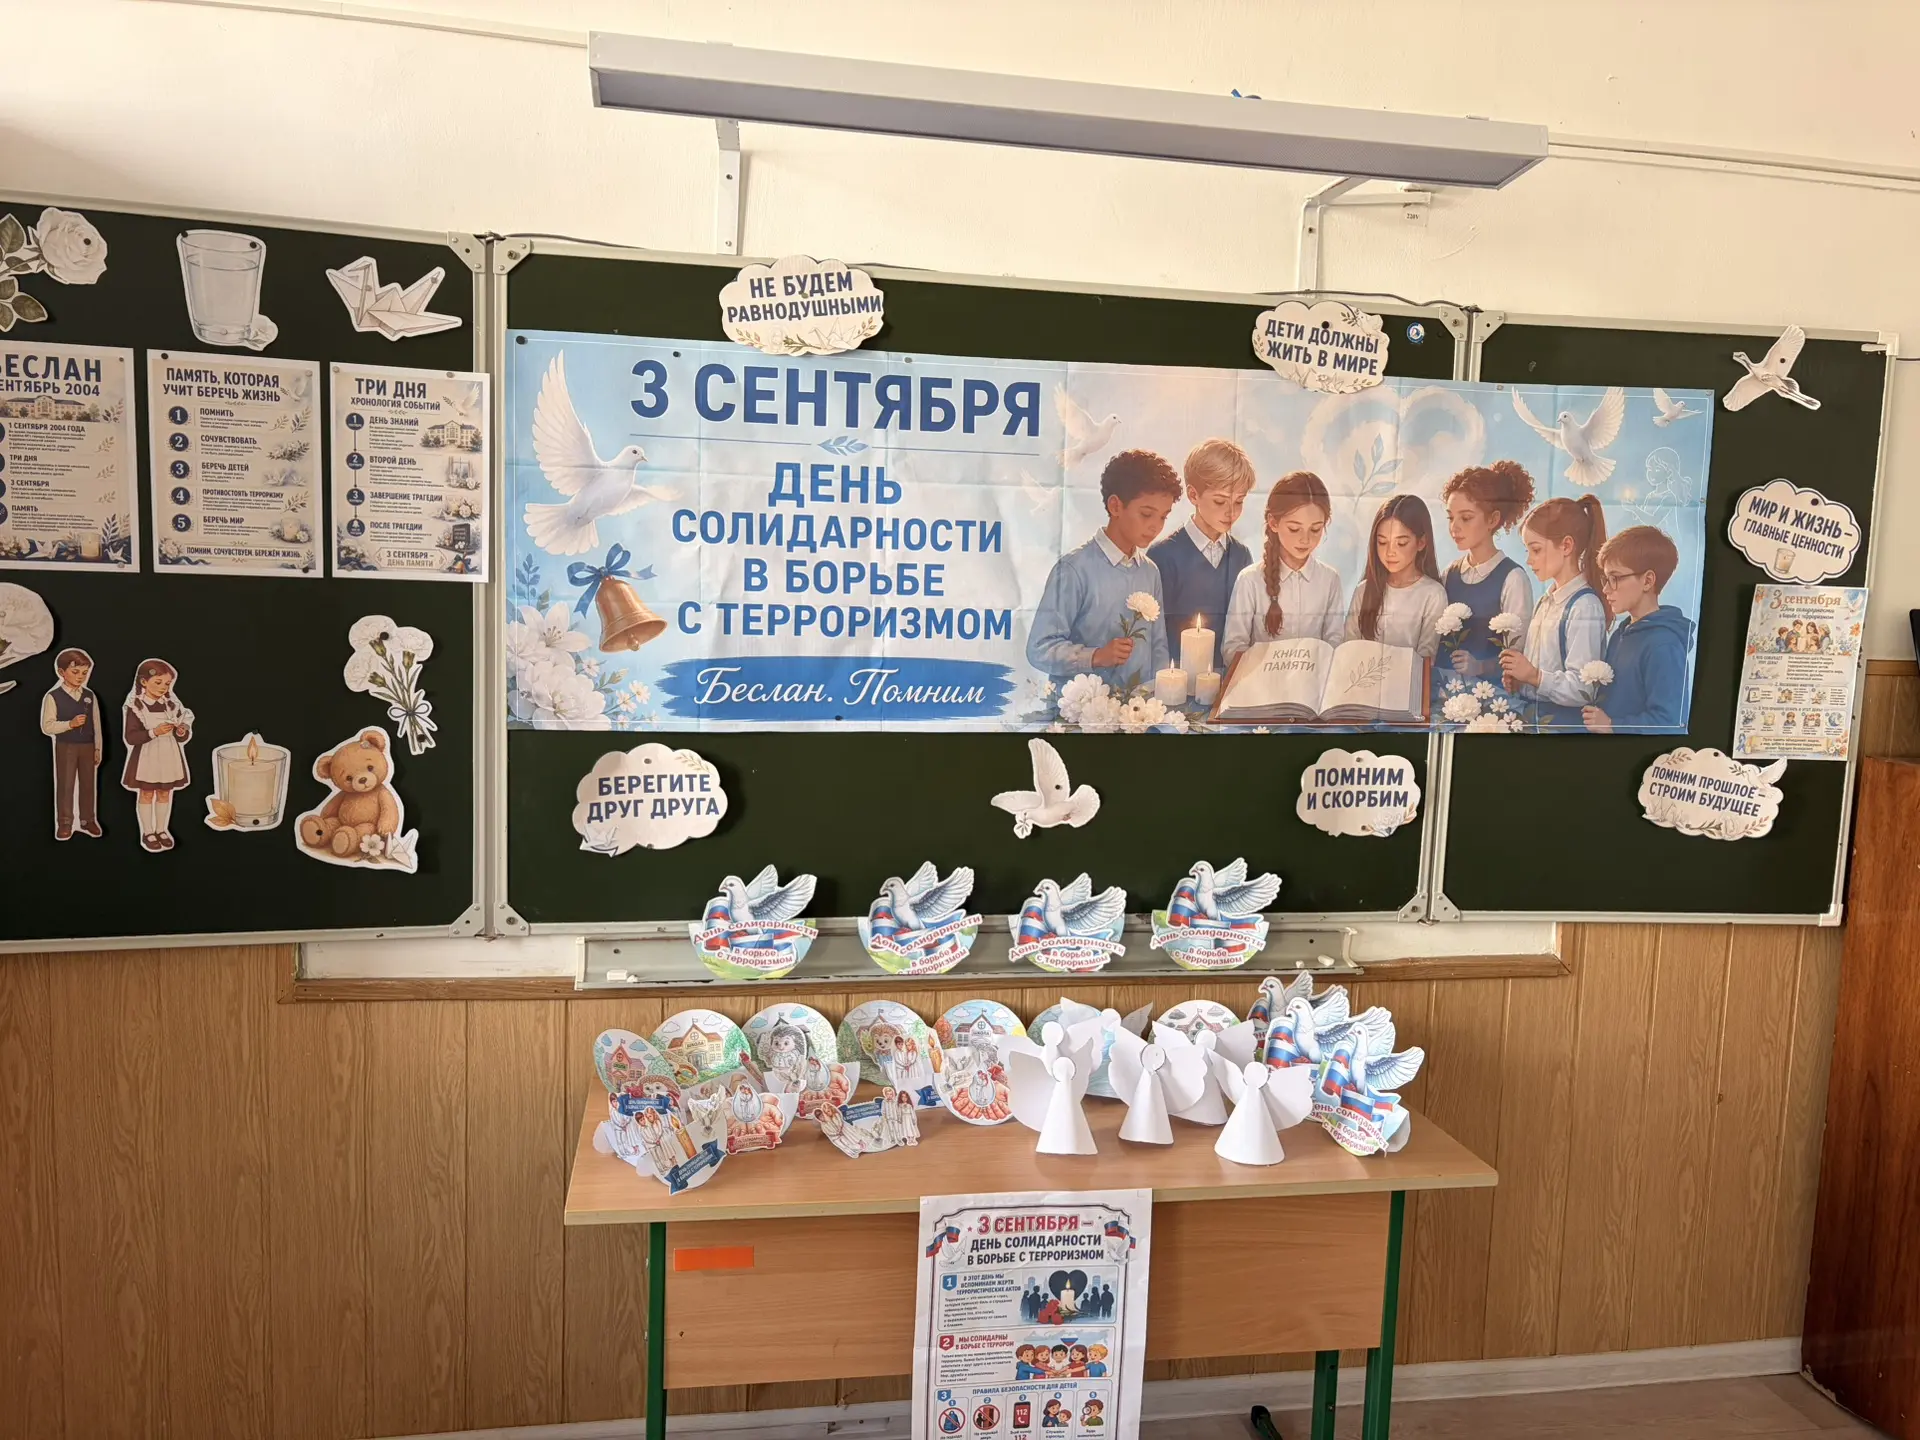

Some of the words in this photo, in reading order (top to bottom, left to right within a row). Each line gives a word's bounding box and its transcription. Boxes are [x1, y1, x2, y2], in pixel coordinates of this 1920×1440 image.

[750, 277, 776, 299] НЕ
[783, 271, 853, 297] БУДЕМ
[727, 295, 882, 323] РАВНОДУШНЫМИ
[1265, 318, 1305, 341] ДЕТИ
[1308, 327, 1379, 354] ДОЛЖНЫ
[1266, 339, 1312, 365] ЖИТЬ
[1317, 349, 1328, 367] В
[1332, 352, 1378, 376] МИРЕ
[0, 354, 102, 382] ЕСЛАН
[166, 367, 220, 385] ПАМЯТЬ,
[224, 372, 280, 388] КОТОРАЯ
[65, 383, 100, 396] 2004
[163, 384, 193, 396] УЧИТ
[197, 388, 239, 400] БЕРЕЧЬ
[242, 390, 281, 402] ЖИЗНЬ
[355, 378, 387, 396] ТРИ
[393, 381, 427, 399] ДНЯ
[350, 397, 401, 408] ХРОНОЛОГИЯ
[403, 400, 440, 411] СОБЫТИЙ
[630, 359, 669, 419] 3
[694, 362, 1042, 438] СЕНТЯБРЯ
[175, 410, 182, 421] 1
[200, 407, 234, 418] ПОМНИТЬ
[352, 415, 357, 423] 1
[14, 422, 48, 431] СЕНТЯБРЯ
[369, 416, 389, 426] ДЕНЬ
[390, 417, 419, 427] ЗНАНИЙ
[175, 436, 183, 448] 2
[200, 435, 257, 445] СОЧУВСТВОВАТЬ
[9, 454, 22, 462] ТРИ
[352, 455, 358, 463] 2
[370, 455, 396, 465] ВТОРОЙ
[398, 457, 416, 466] ДЕНЬ
[176, 464, 184, 475] 3
[201, 462, 226, 471] БЕРЕЧЬ
[228, 463, 249, 472] ДЕТЕЙ
[16, 480, 50, 488] СЕНТЯБРЯ
[767, 462, 903, 509] ДЕНЬ
[176, 491, 184, 502] 4
[202, 489, 249, 498] ПРОТИВОСТОЯТЬ
[249, 490, 284, 499] ТЕРРОРИЗМУ
[353, 491, 358, 499] 3
[370, 491, 410, 501] ЗАВЕРШЕНИЕ
[412, 493, 443, 502] ТРАГЕДИИ
[11, 505, 38, 513] ПАМЯТЬ
[177, 518, 185, 529] 5
[203, 515, 228, 524] БЕРЕЧЬ
[230, 516, 244, 524] МИР
[1748, 496, 1778, 519] МИР
[1778, 505, 1791, 524] И
[1790, 509, 1843, 539] ЖИЗНЬ
[370, 521, 391, 530] ПОСЛЕ
[392, 522, 423, 531] ТРАГЕДИИ
[672, 508, 1003, 554] СОЛИДАРНОСТИ
[1743, 518, 1791, 544] ГЛАВНЫЕ
[1791, 532, 1845, 559] ЦЕННОСТИ
[254, 548, 280, 558] БЕРЕЖЁМ
[392, 551, 428, 559] СЕНТЯБРЯ
[387, 559, 404, 567] ДЕНЬ
[406, 559, 433, 567] ПАМЯТИ
[743, 558, 769, 593] В
[785, 559, 945, 597] БОРЬБЕ
[1769, 589, 1782, 610] 3
[1784, 593, 1842, 608] сентября
[677, 601, 702, 635] С
[716, 602, 1012, 641] ТЕРРОРИЗМОМ
[1272, 648, 1311, 659] КНИГА
[1263, 660, 1315, 672] ПАМЯТИ
[694, 665, 833, 706] Беслан.
[846, 667, 987, 708] Помним
[1314, 768, 1405, 787] ПОМНИМ
[1651, 766, 1697, 786] ПОМНИМ
[1698, 776, 1757, 799] ПРОШЛОЕ
[598, 774, 712, 797] БЕРЕГИТЕ
[1307, 792, 1317, 810] И
[1321, 791, 1409, 809] СКОРБИМ
[1650, 782, 1697, 804] СТРОИМ
[1698, 792, 1761, 817] БУДУЩЕЕ
[587, 799, 644, 824] ДРУГ
[650, 798, 720, 820] ДРУГА
[693, 927, 725, 944] День
[728, 920, 817, 937] солидарности
[900, 916, 981, 955] солидарности
[1152, 933, 1179, 946] День
[1182, 929, 1264, 948] солидарности
[742, 948, 776, 958] борьбе
[1010, 945, 1039, 960] День
[1042, 938, 1124, 953] солидарности
[1060, 950, 1092, 959] борьбе
[1196, 948, 1227, 957] борьбе
[726, 954, 793, 967] терроризмом
[907, 950, 967, 975] терроризмом
[919, 950, 950, 966] борьбе
[1045, 955, 1109, 967] терроризмом
[1182, 954, 1242, 965] терроризмом
[1313, 1103, 1334, 1113] ень
[1336, 1106, 1388, 1149] солидарност
[1330, 1127, 1374, 1152] терроризмом
[1343, 1126, 1366, 1142] борьбе
[977, 1216, 990, 1234] 3
[994, 1215, 1079, 1233] СЕНТЯБРЯ
[970, 1238, 1002, 1253] ДЕНЬ
[1004, 1234, 1102, 1250] СОЛИДАРНОСТИ
[967, 1256, 974, 1266] В
[977, 1252, 1016, 1265] БОРЬБЕ
[1019, 1251, 1026, 1262] С
[1028, 1249, 1104, 1262] ТЕРРОРИЗМОМ
[946, 1277, 953, 1287] 1
[943, 1337, 950, 1347] 2
[970, 1334, 1008, 1342] СОЛИДАРНЫ
[1001, 1384, 1045, 1393] БЕЗОПАСНОСТИ
[941, 1391, 947, 1400] 3
[1016, 1408, 1028, 1416] 112
